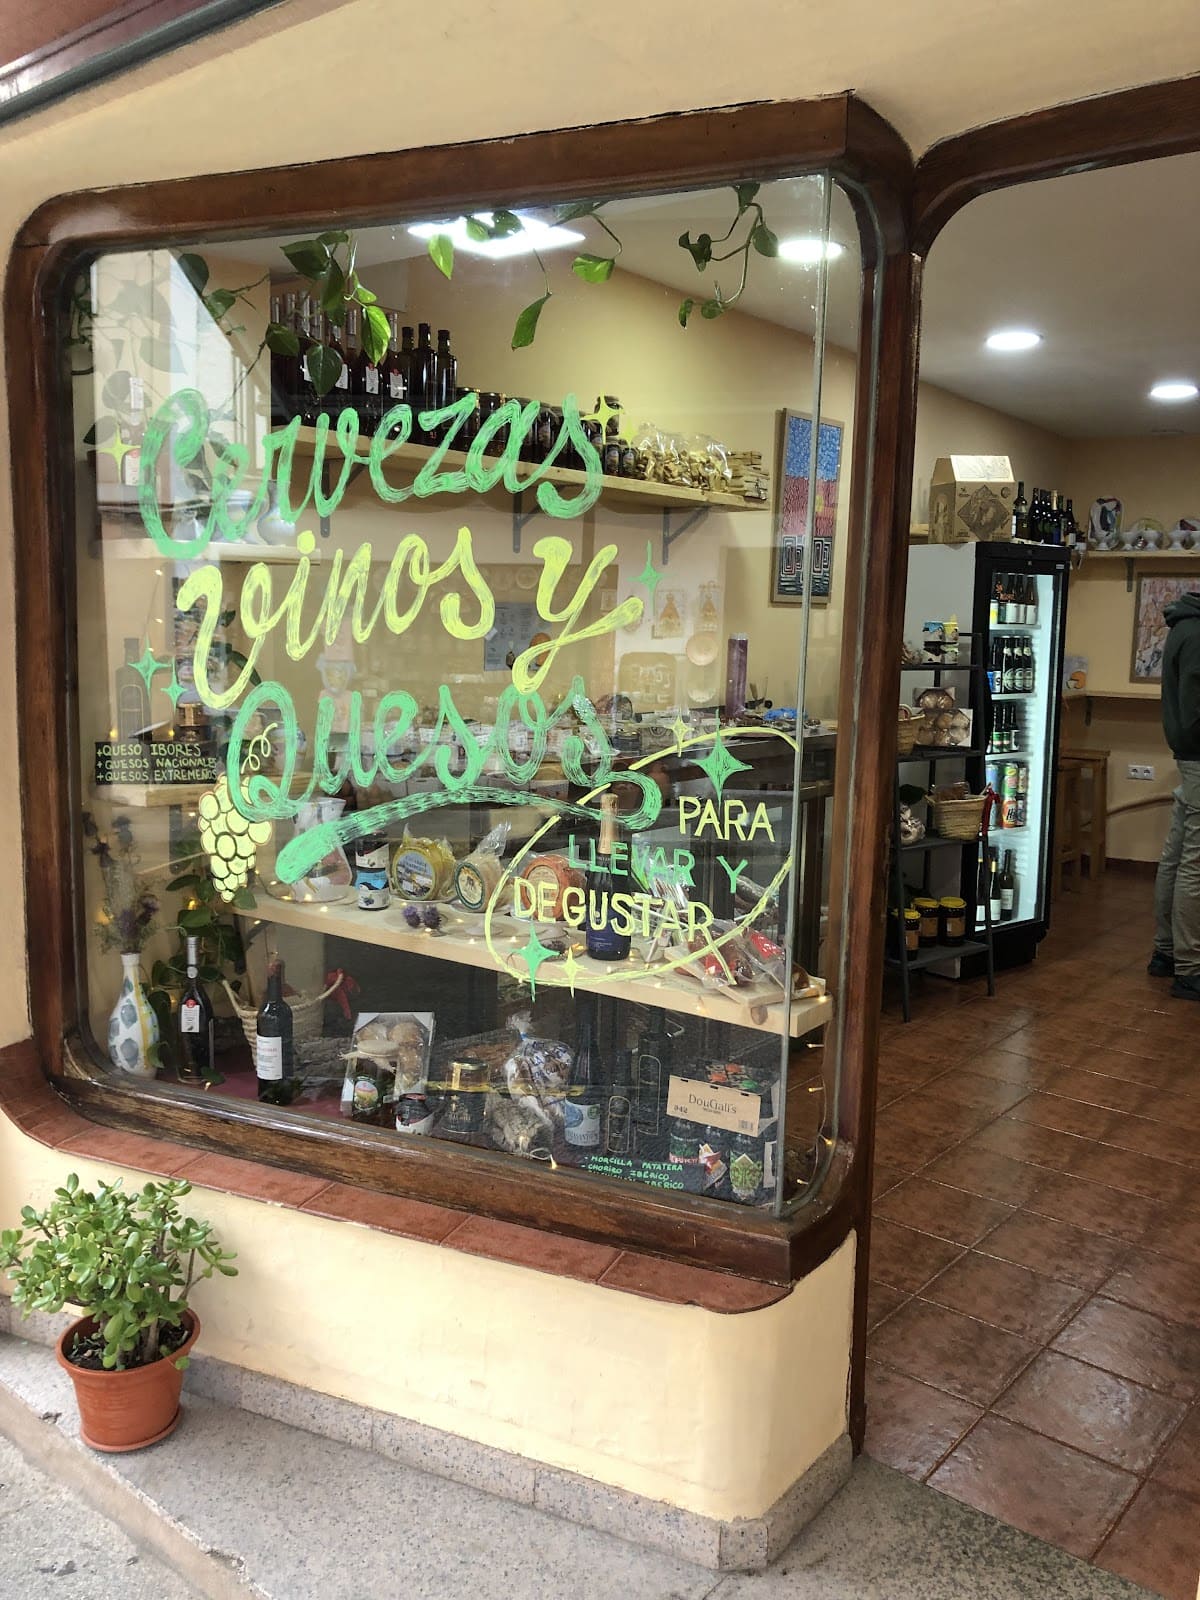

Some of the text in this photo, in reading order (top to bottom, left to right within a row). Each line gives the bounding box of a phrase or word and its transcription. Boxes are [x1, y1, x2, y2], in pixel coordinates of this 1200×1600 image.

[140, 388, 602, 560] Cervezas
[151, 743, 201, 756] IBORES
[156, 757, 217, 769] NACIONALES
[227, 675, 617, 823] Quesos
[679, 796, 775, 842] PARA
[568, 834, 748, 894] LLEVAR Y
[514, 876, 737, 985] DEGUSTAR
[590, 1155, 683, 1171] MORCILLA PATATERA
